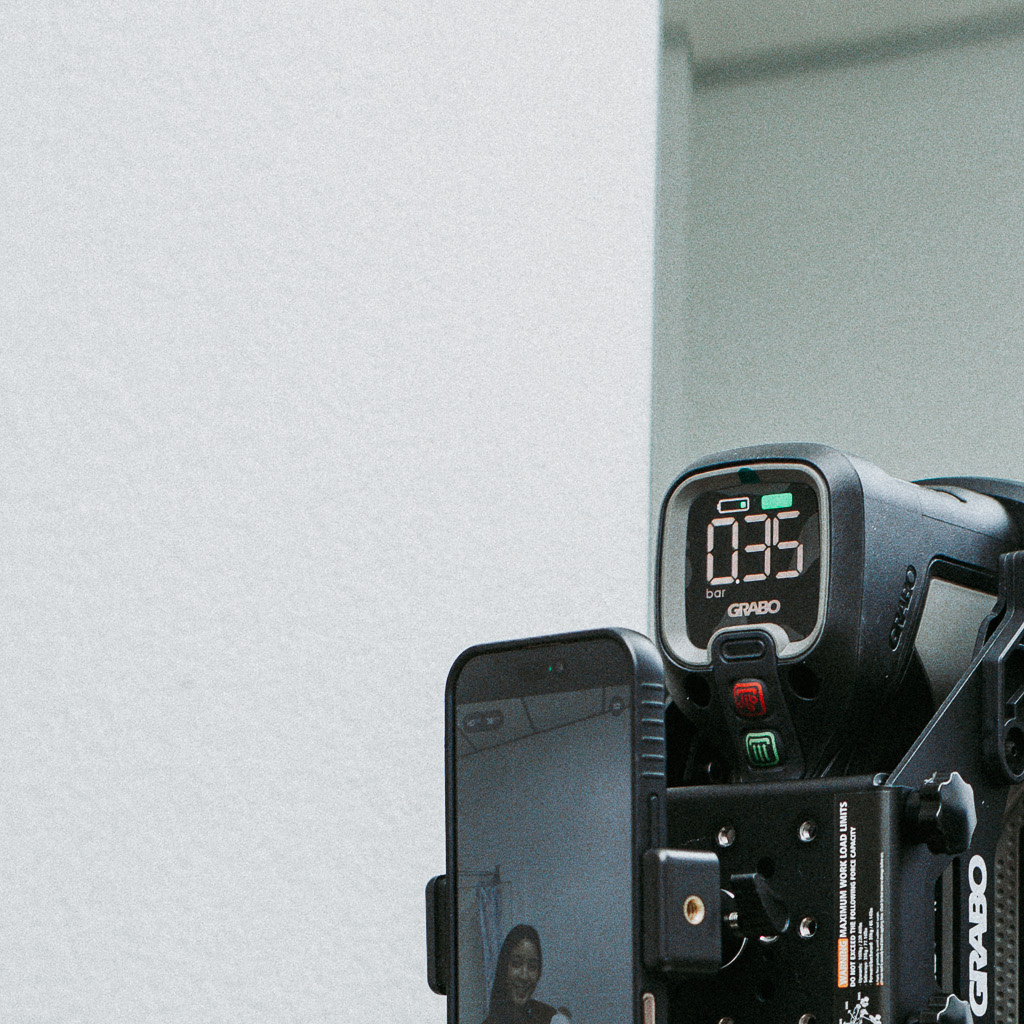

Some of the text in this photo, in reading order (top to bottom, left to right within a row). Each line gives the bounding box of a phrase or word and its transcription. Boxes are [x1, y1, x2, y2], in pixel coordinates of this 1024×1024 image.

[706, 588, 727, 599] bar
[727, 599, 782, 618] GRABO
[839, 801, 847, 986] WARNING MAXIMUM WORK LOAD LIMITS
[968, 854, 988, 1017] GRABO
[850, 976, 856, 987] DO
